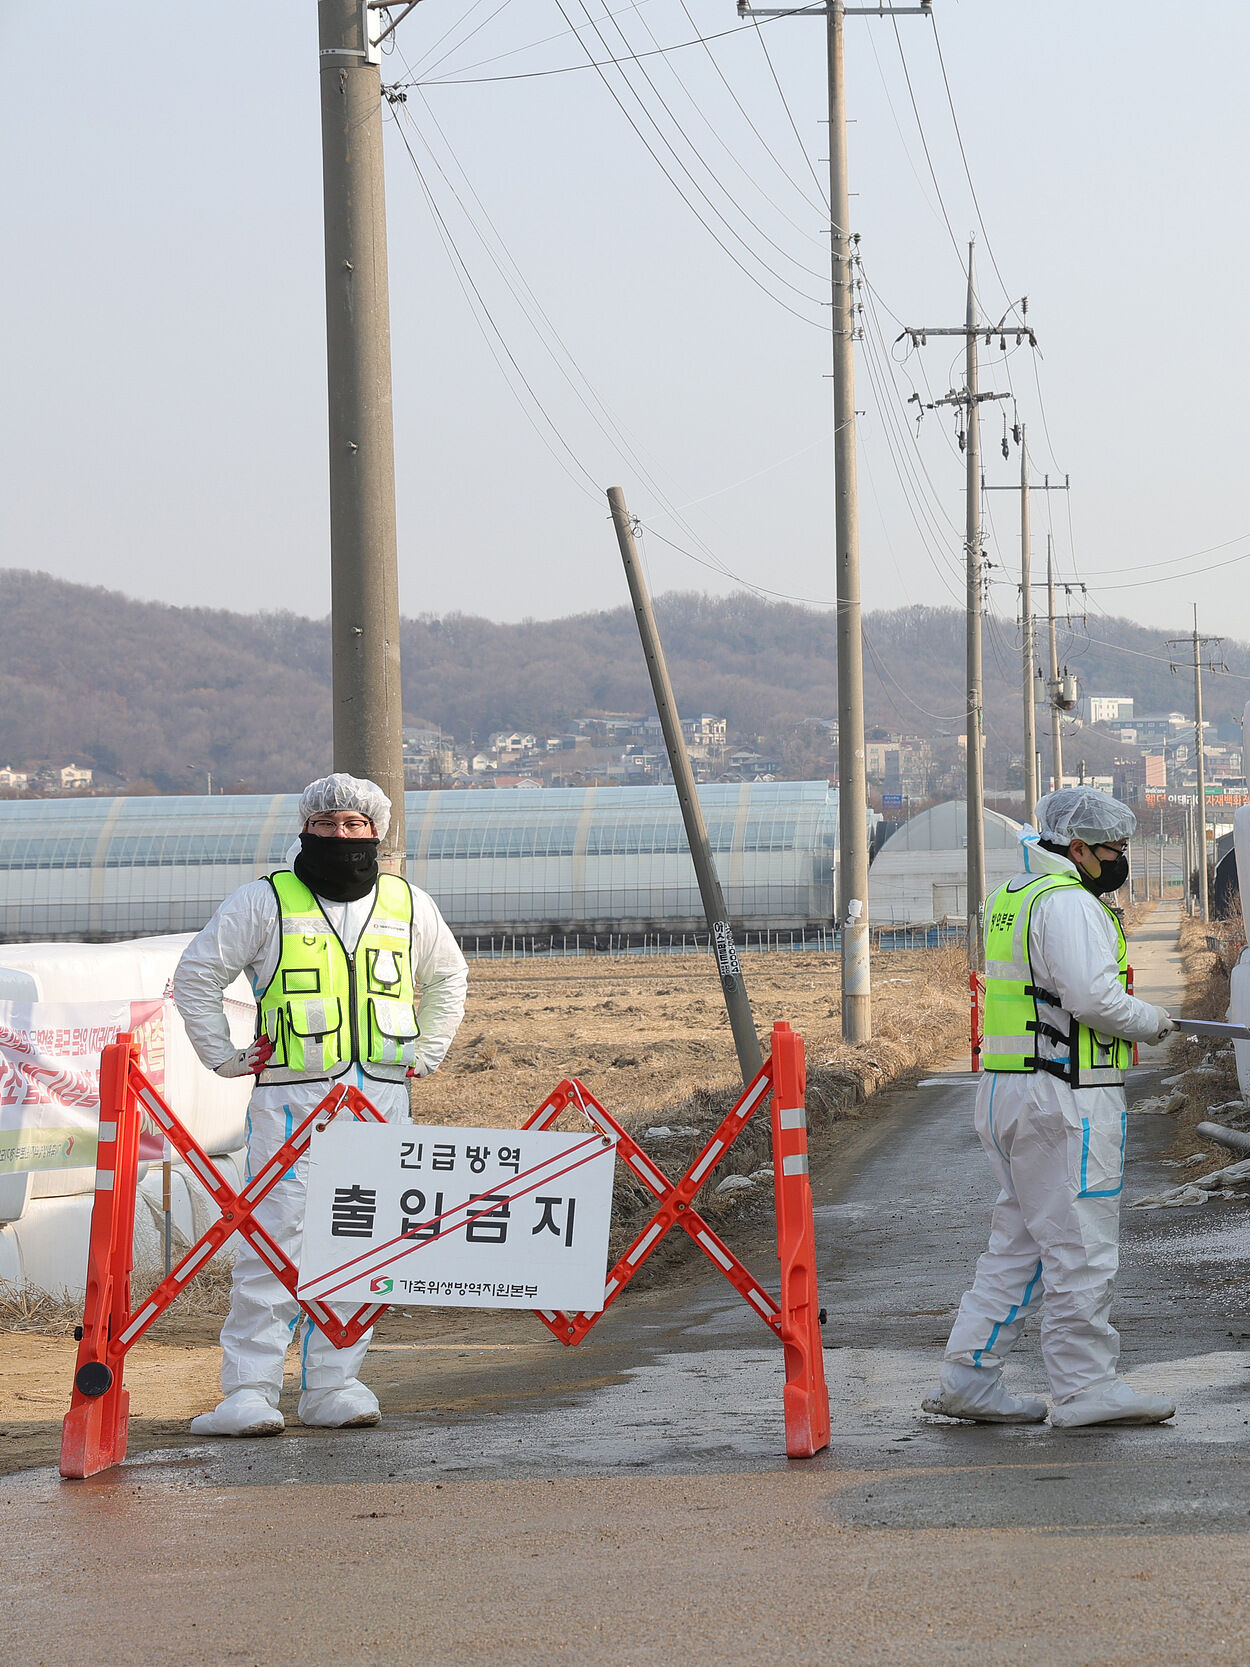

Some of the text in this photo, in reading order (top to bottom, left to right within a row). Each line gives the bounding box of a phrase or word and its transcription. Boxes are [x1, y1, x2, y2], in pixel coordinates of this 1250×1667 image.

[400, 1141, 522, 1174] 긴급방역
[331, 1184, 577, 1248] 출입금지
[400, 1278, 538, 1299] 가축위생방역지원본부
